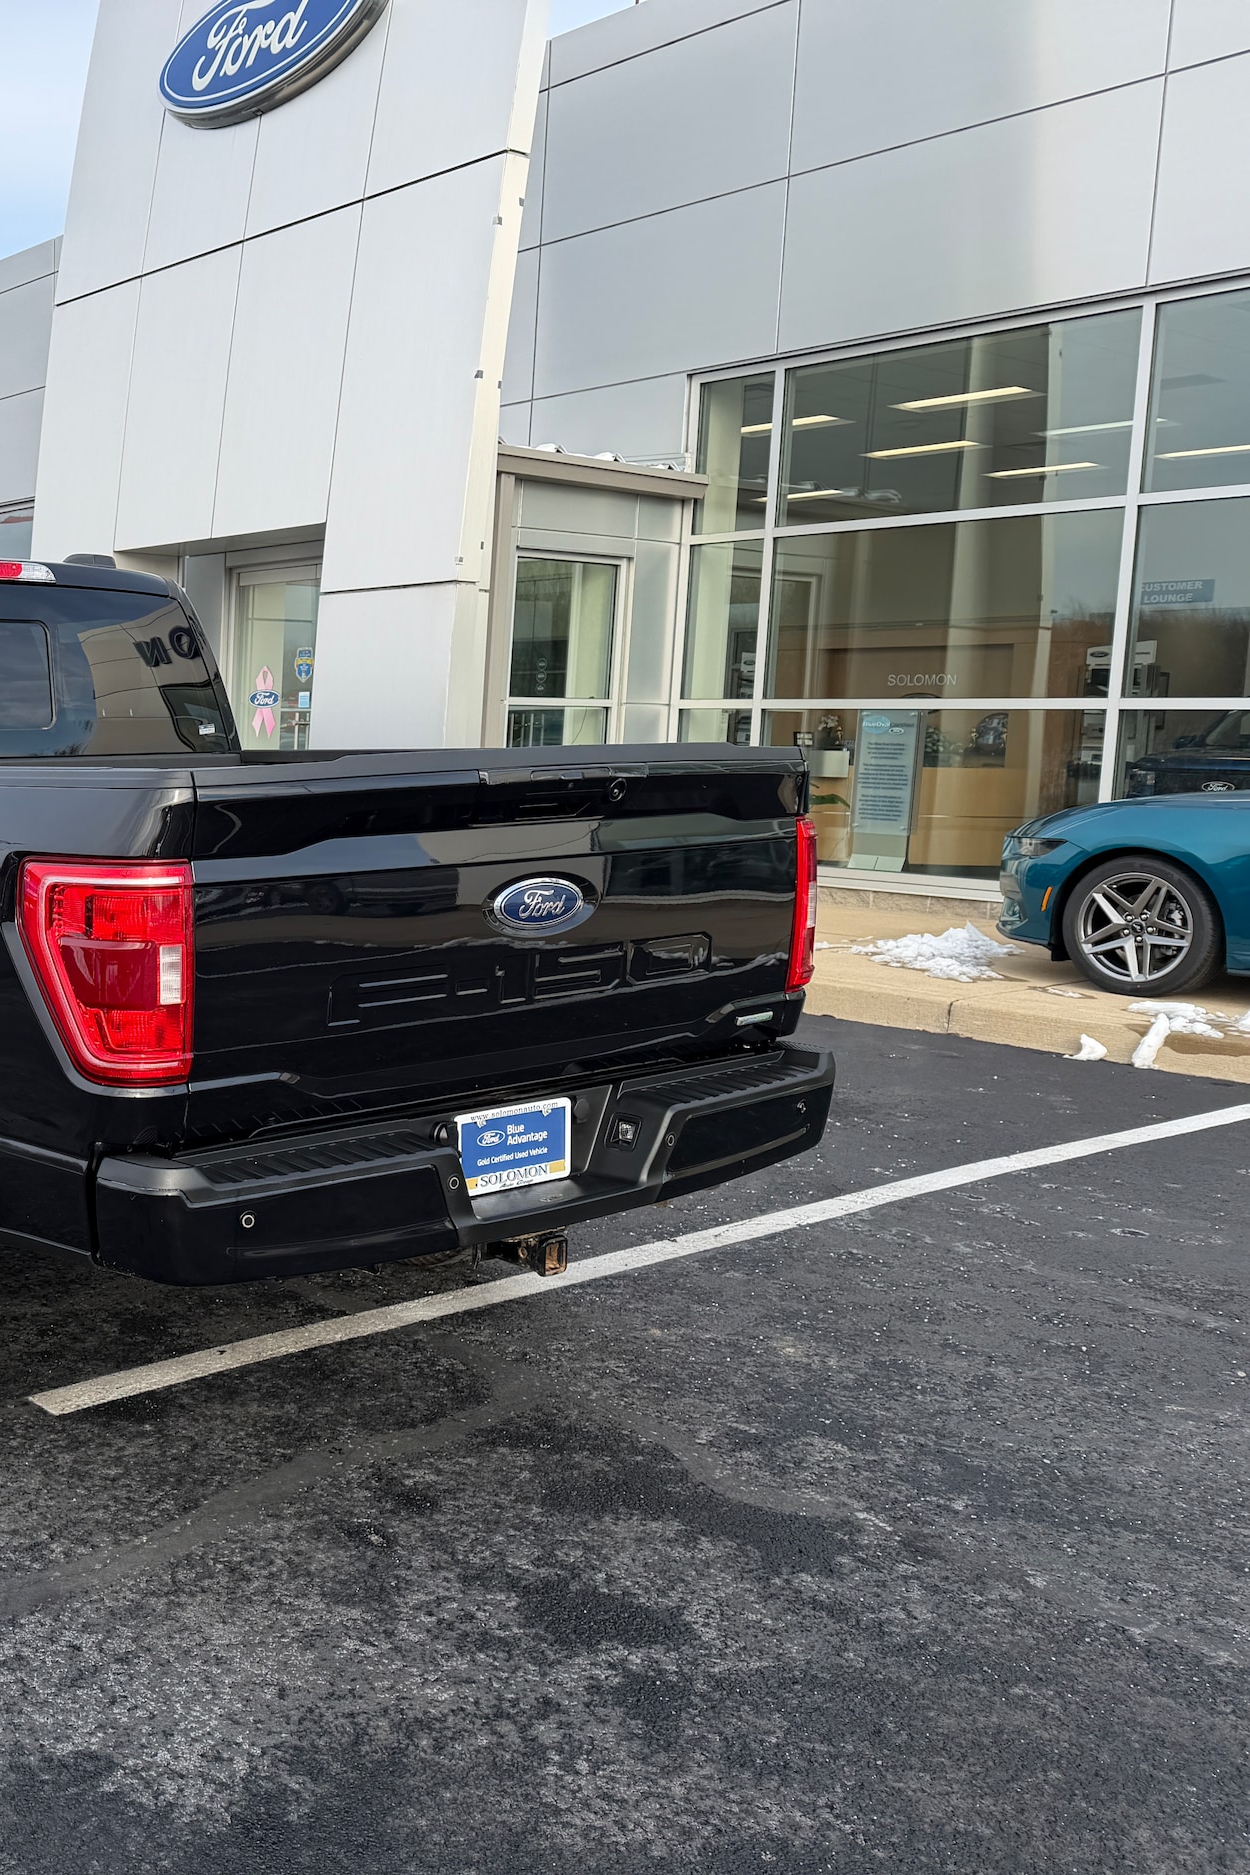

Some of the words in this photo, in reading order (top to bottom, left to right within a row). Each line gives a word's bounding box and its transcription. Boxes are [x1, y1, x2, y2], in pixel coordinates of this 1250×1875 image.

[191, 0, 308, 91] Ford
[1144, 593, 1193, 603] LOUNGE
[887, 673, 957, 686] SOLOMON
[254, 692, 275, 705] Ford
[518, 889, 566, 919] Ford
[327, 931, 713, 1027] F-150
[470, 1101, 559, 1121] www.solomonauto.com
[481, 1132, 501, 1144] Ford
[506, 1124, 525, 1134] Blue
[506, 1130, 549, 1146] Advantage
[477, 1157, 490, 1166] Gold
[490, 1153, 514, 1164] Certified
[515, 1149, 529, 1159] Used
[529, 1146, 549, 1156] Vehicle
[480, 1164, 549, 1187] SOLOMON
